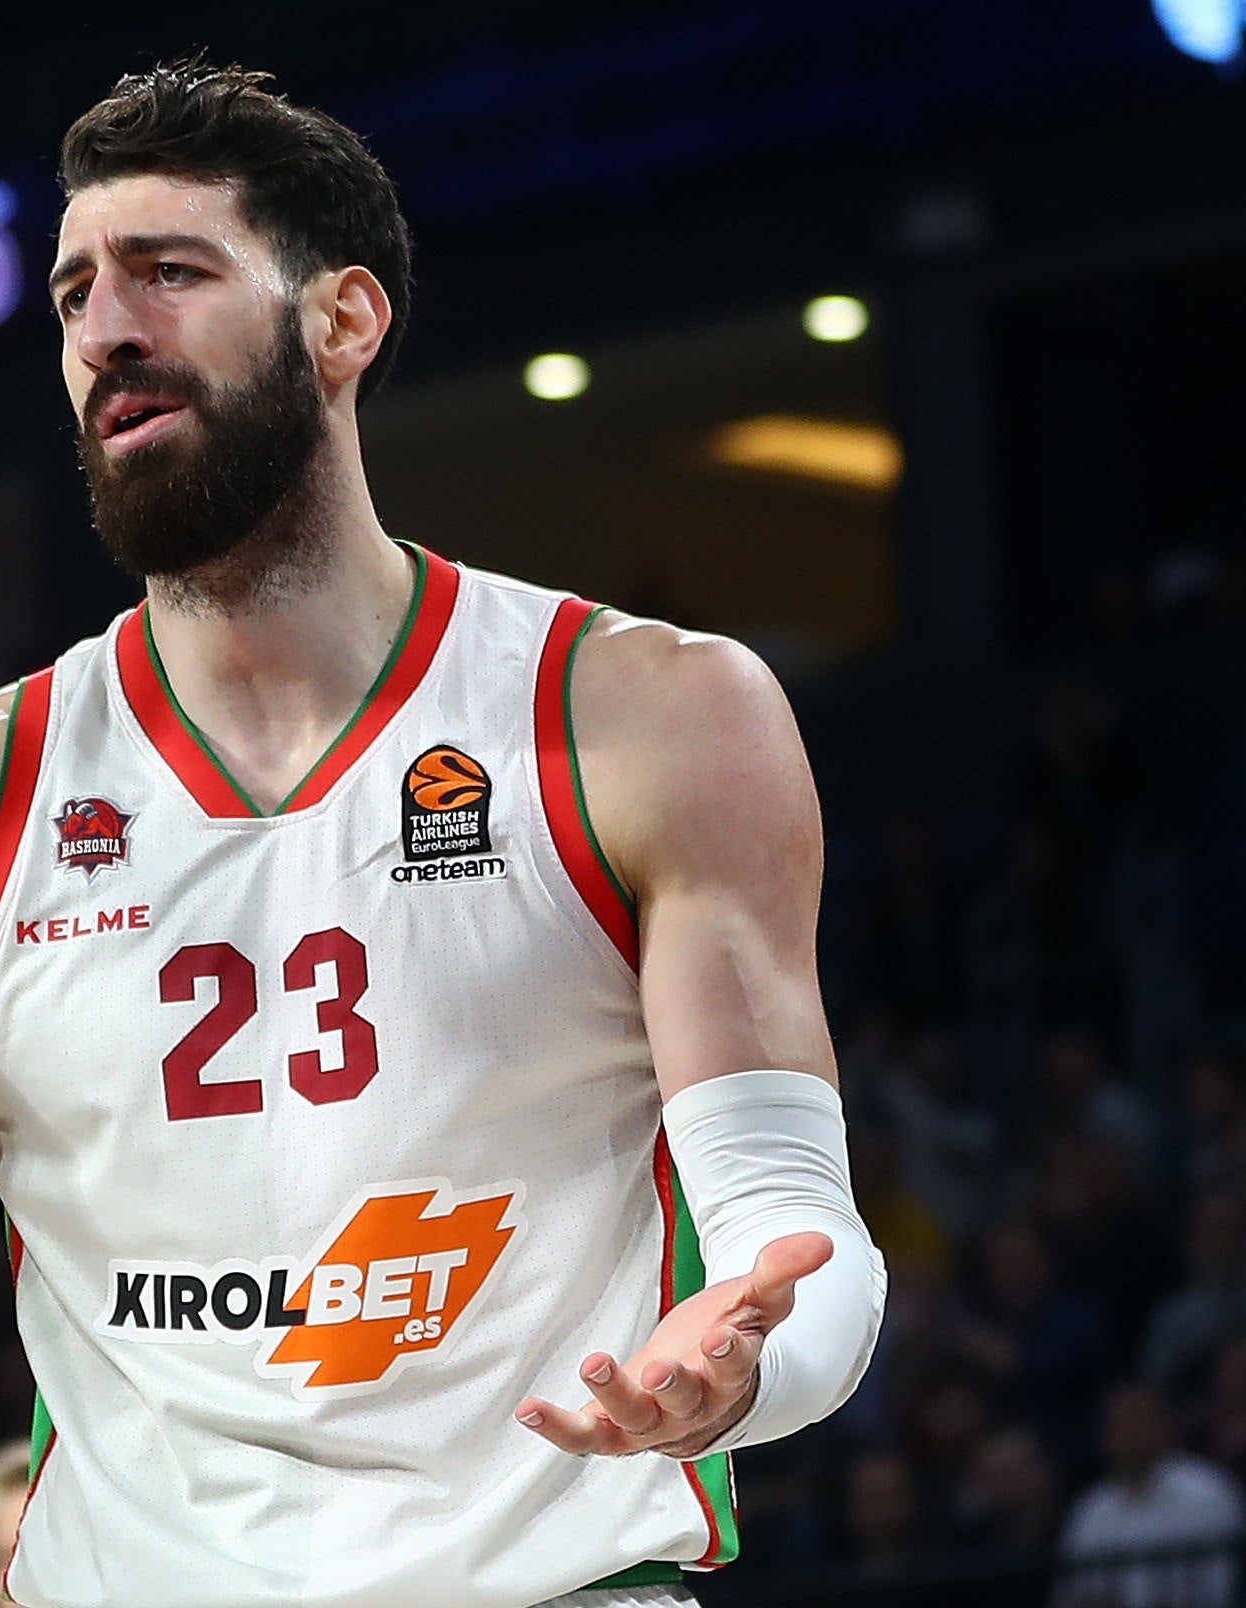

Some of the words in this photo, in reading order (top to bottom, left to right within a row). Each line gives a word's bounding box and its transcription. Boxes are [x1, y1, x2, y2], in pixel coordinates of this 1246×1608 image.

[410, 811, 479, 827] TURKISH
[411, 823, 479, 842] AIRLINES
[411, 837, 481, 853] EuroLeague
[391, 857, 505, 882] oneteam
[16, 905, 151, 944] KELME
[158, 926, 380, 1122] 23
[108, 1247, 468, 1331] KIROLBET
[393, 1313, 442, 1344] .es
